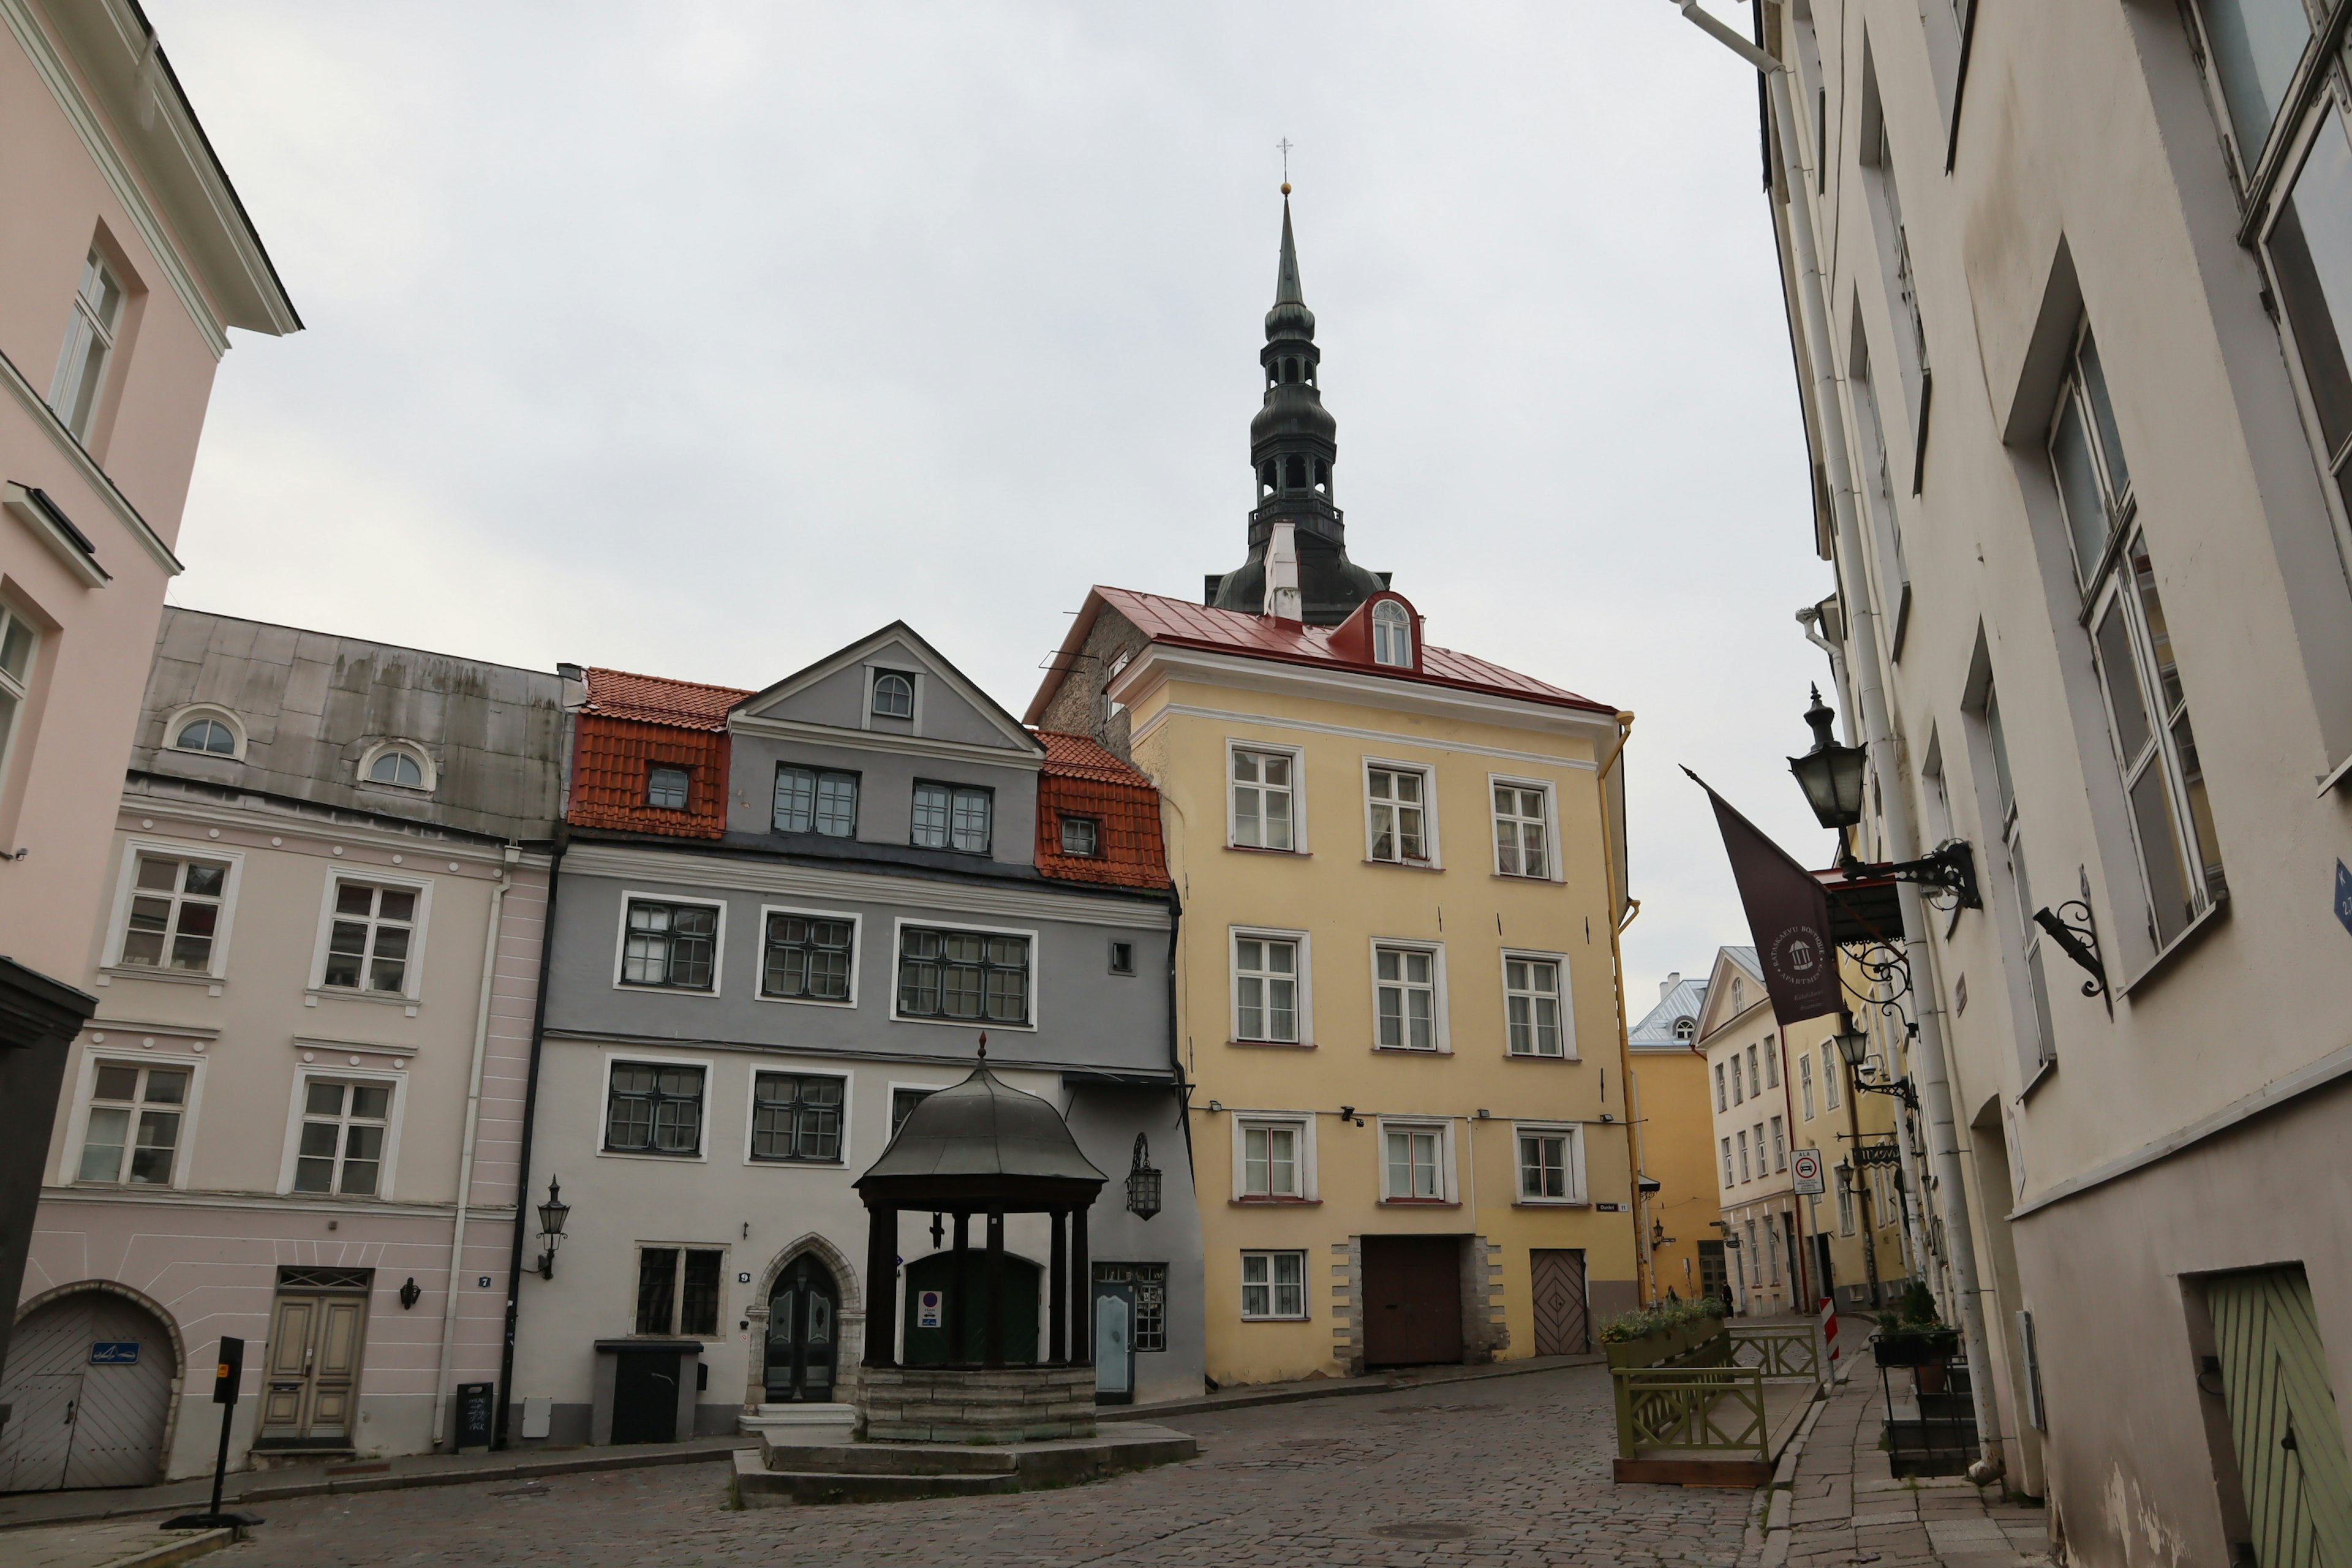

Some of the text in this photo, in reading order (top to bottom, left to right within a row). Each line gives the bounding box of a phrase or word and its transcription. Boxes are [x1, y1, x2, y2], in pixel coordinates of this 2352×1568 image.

[1771, 925, 1825, 967] RATASKAEVU BOUTIQUE
[1780, 963, 1823, 985] APARTMENTS
[481, 1278, 489, 1286] 7
[741, 1273, 748, 1282] 9
